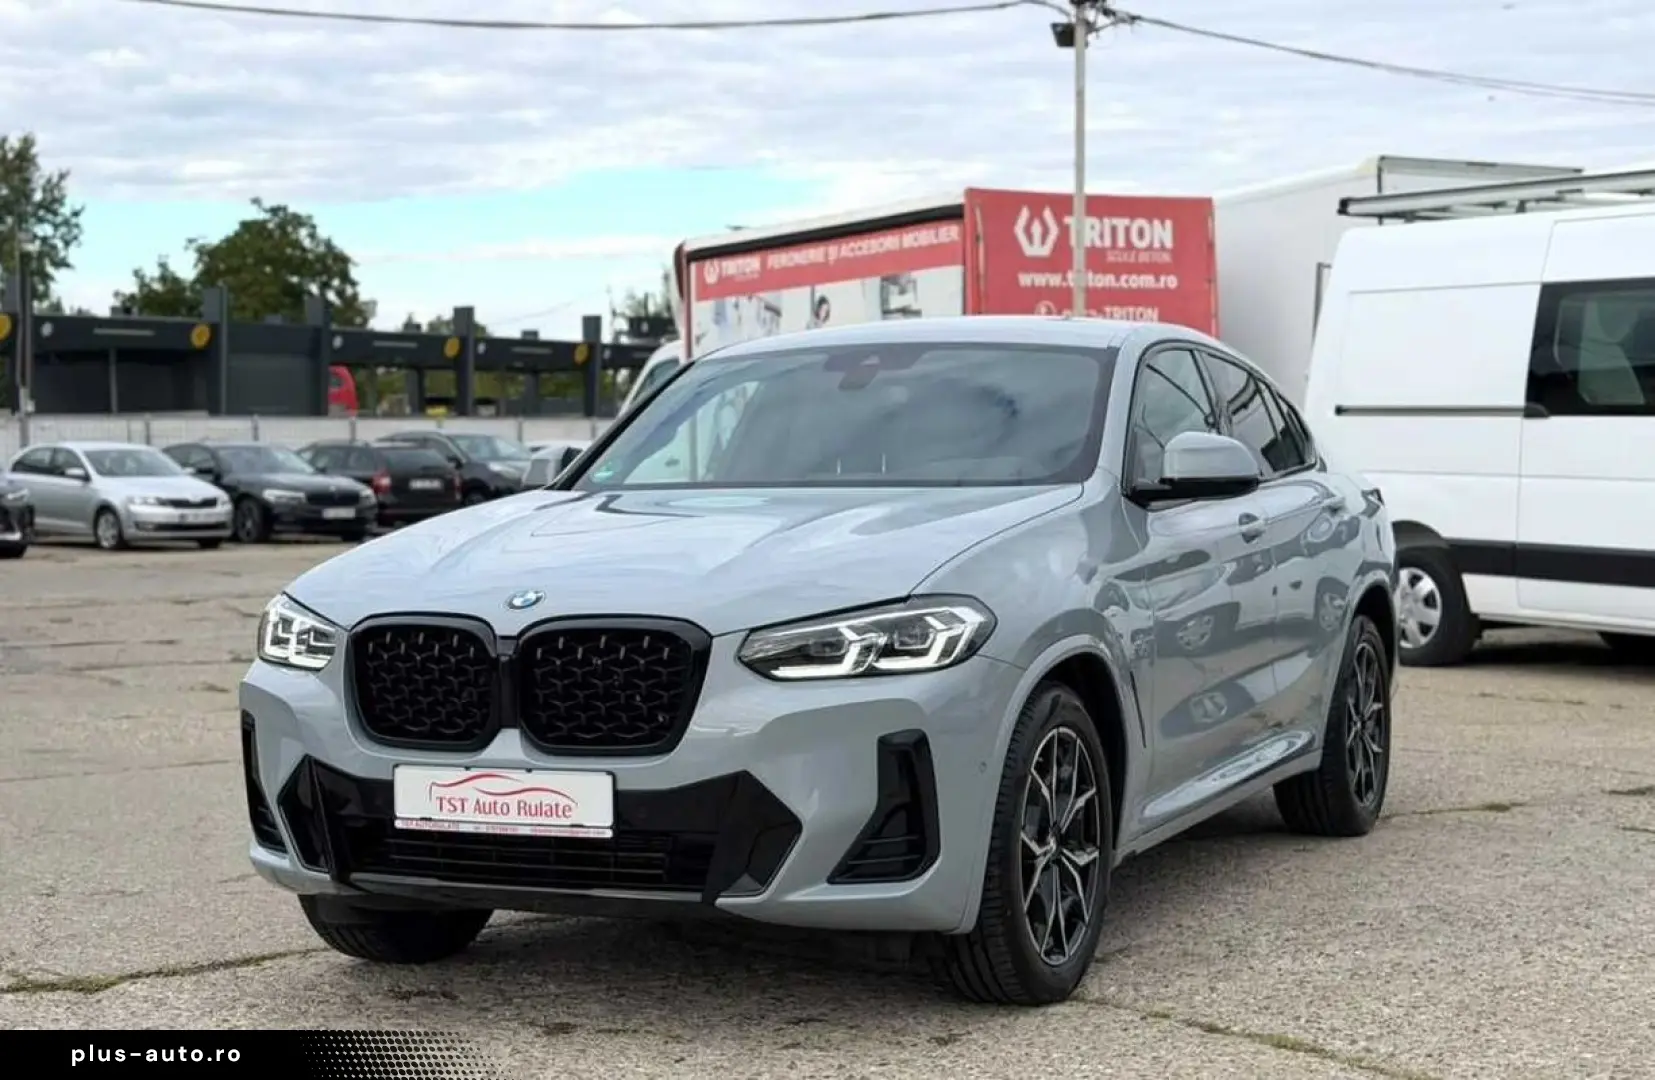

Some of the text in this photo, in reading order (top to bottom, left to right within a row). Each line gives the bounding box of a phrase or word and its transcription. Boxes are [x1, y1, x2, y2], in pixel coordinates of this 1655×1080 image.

[902, 226, 960, 248] MOBILIER
[1063, 216, 1173, 249] TRITON
[1018, 270, 1178, 289] www.tton.com.ro
[436, 796, 573, 819] TST Auto Rulate
